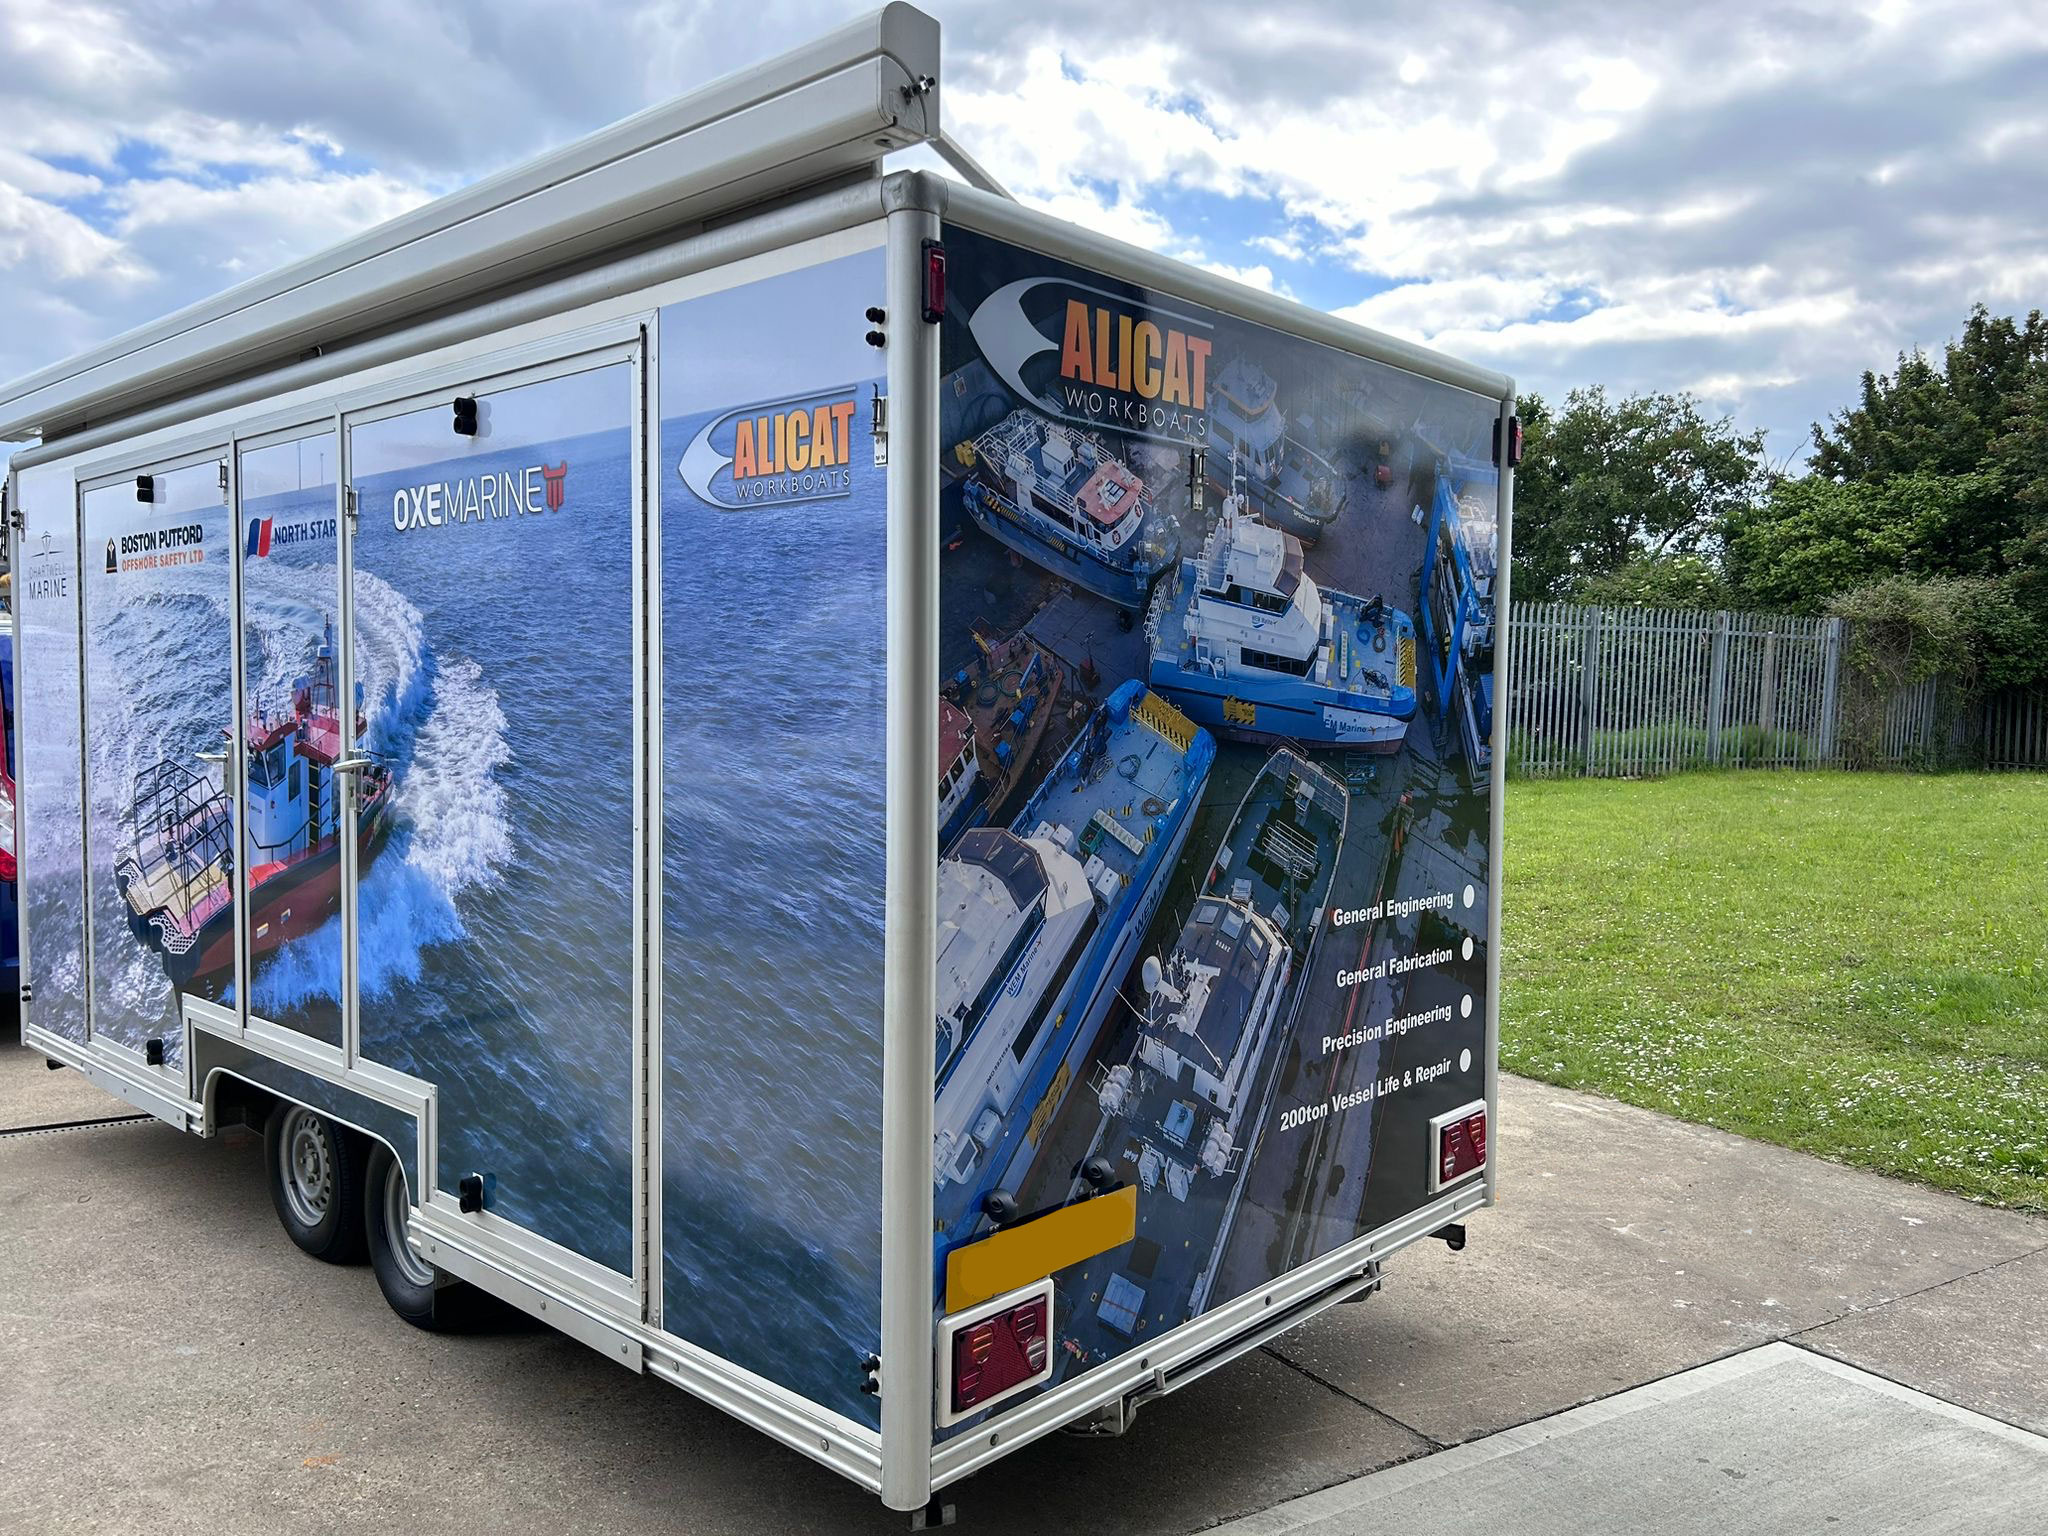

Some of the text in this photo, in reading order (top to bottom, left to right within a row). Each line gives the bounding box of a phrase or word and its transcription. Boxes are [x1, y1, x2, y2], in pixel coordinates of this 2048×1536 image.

[1061, 299, 1212, 410] ALICAT
[1065, 386, 1205, 436] WORKBOATS
[734, 401, 855, 480] ALICAT
[737, 469, 850, 498] WORKBOATS
[121, 525, 203, 555] BOSTON PUTFORD
[274, 518, 337, 544] NORTH STAR
[29, 562, 66, 579] CHARTWELL
[121, 549, 204, 573] OFFSHORE SAFETY LTD
[29, 578, 67, 600] MARINE
[1339, 722, 1367, 733] Marine
[1333, 892, 1454, 927] General Engineering
[1006, 948, 1038, 995] WEM Marine
[1336, 947, 1453, 988] General Fabrication
[1322, 1004, 1452, 1054] Precision Engineering
[1280, 1058, 1452, 1131] 200ton Vessel Life & Repair
